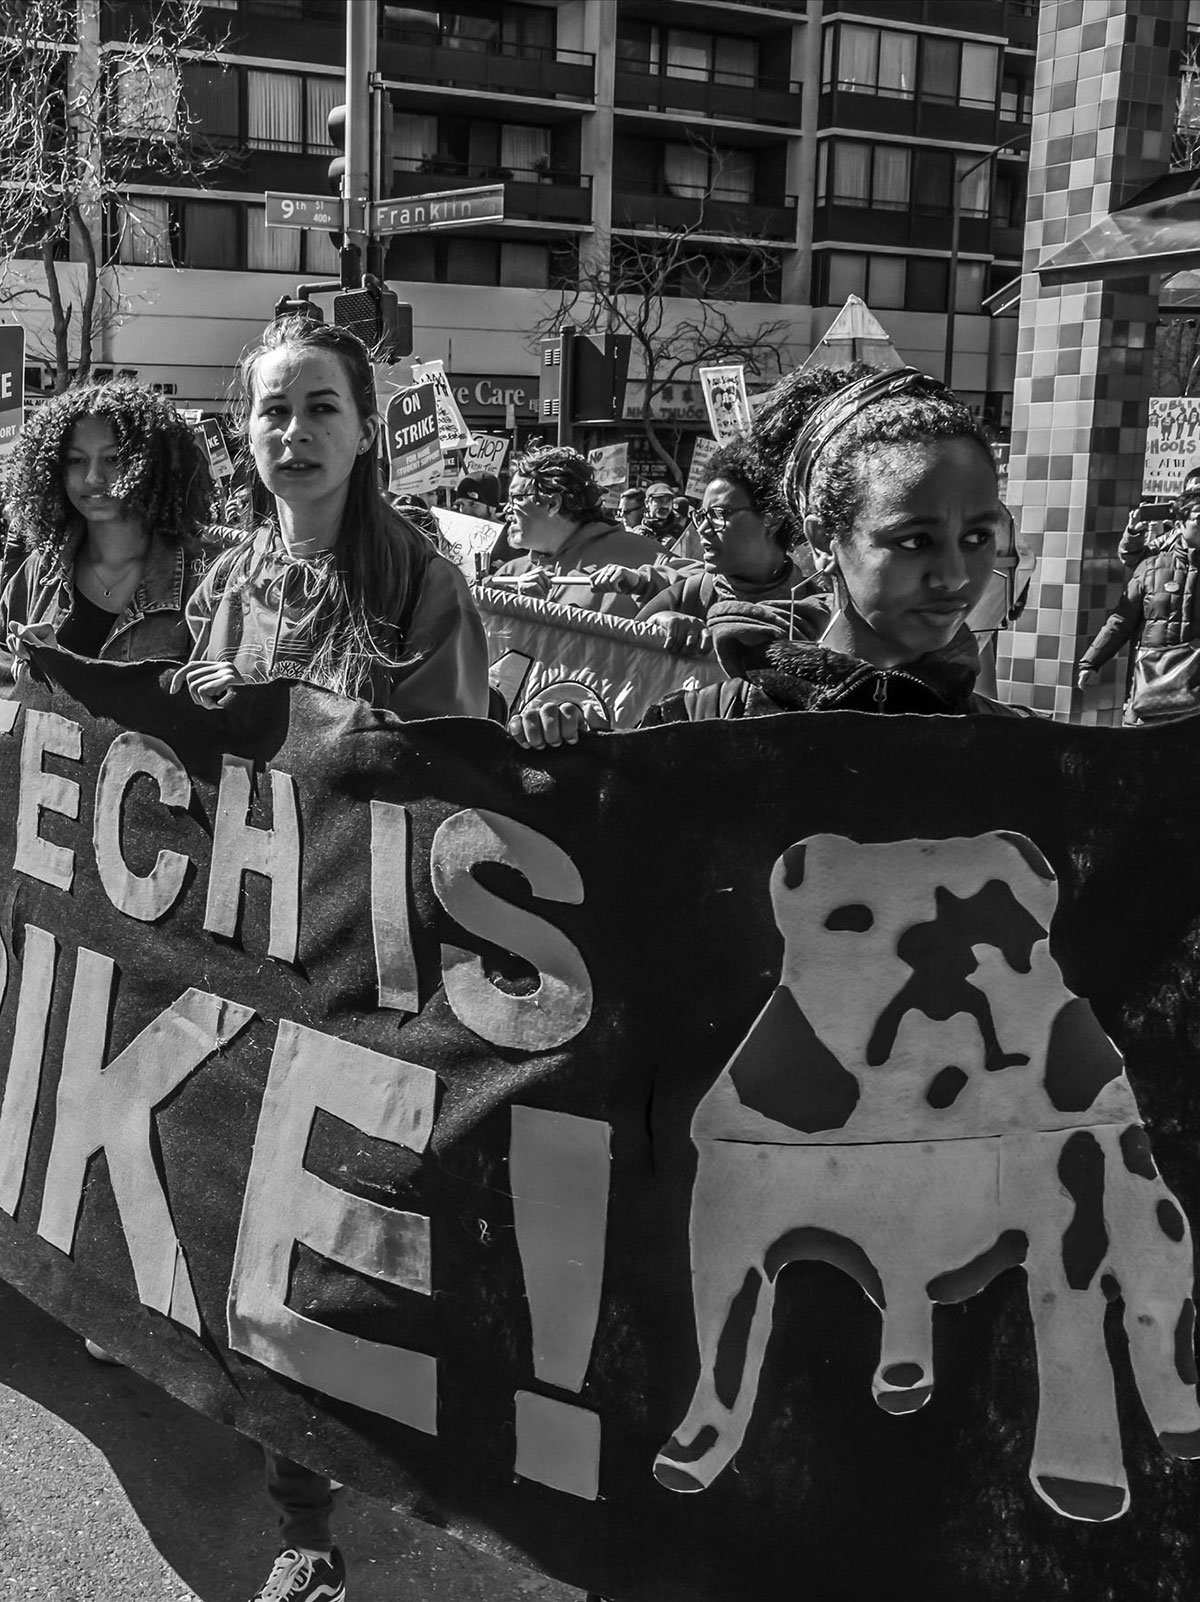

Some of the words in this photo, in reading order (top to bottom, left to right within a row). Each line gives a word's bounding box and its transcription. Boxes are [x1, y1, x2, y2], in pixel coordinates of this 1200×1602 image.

[377, 201, 472, 226] Franklin
[402, 392, 421, 415] ON
[475, 380, 525, 406] Care
[1151, 400, 1200, 412] PUBLI
[395, 414, 435, 449] STRIKE
[371, 800, 594, 1052] IS
